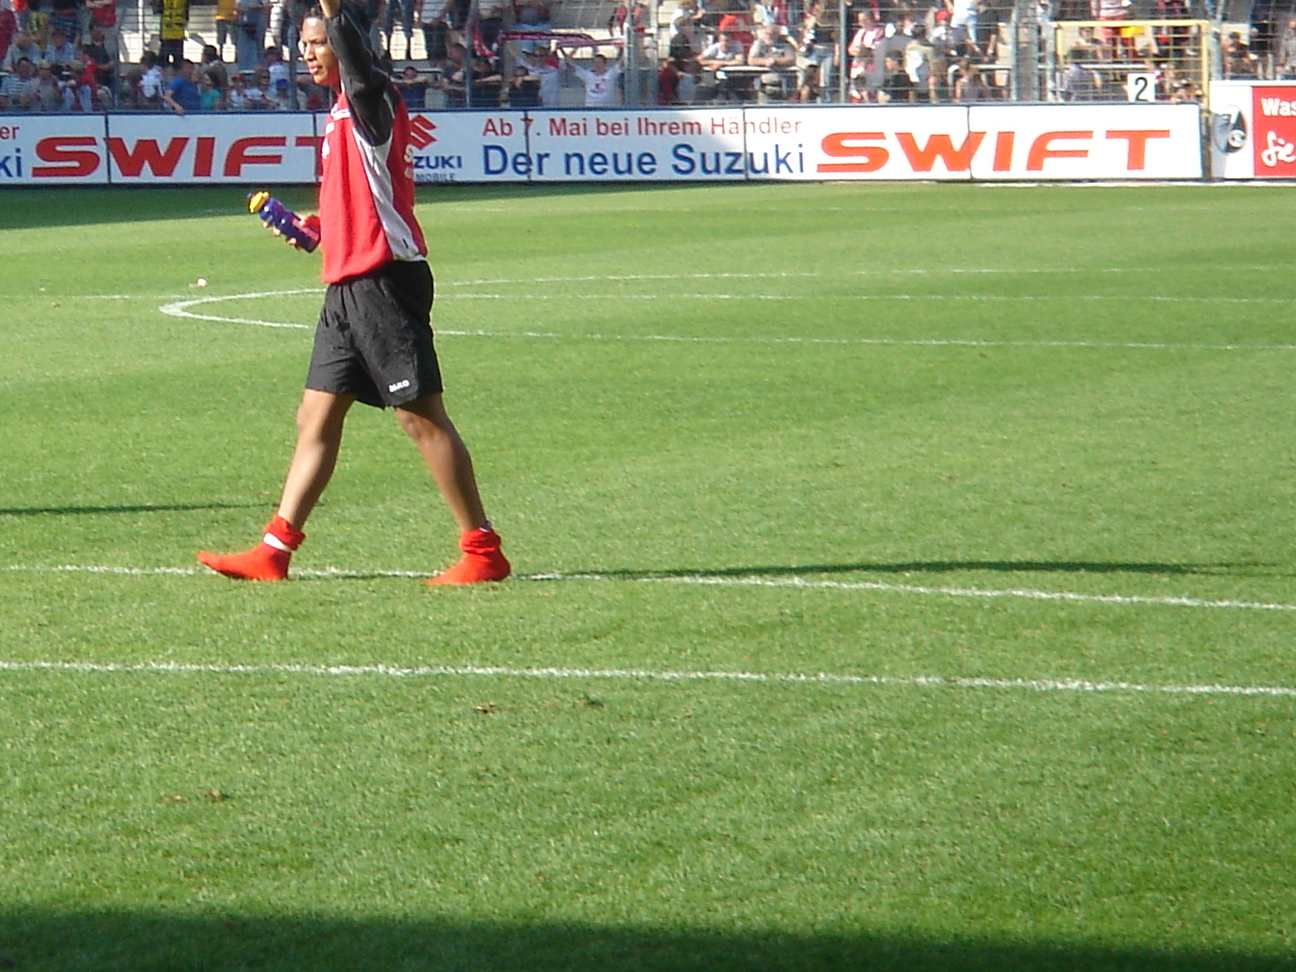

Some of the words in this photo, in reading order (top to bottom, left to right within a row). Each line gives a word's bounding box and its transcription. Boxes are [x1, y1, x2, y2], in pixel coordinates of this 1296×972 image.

[1134, 76, 1149, 102] 2
[482, 117, 513, 137] Ab
[521, 117, 541, 137] 7.
[549, 117, 587, 137] Mai
[595, 117, 629, 136] bei
[637, 117, 702, 136] Ihrem
[710, 116, 802, 135] Händler
[482, 144, 550, 176] Der
[564, 151, 657, 176] neue
[671, 143, 805, 175] Suzuki
[816, 130, 1171, 173] SWIFT
